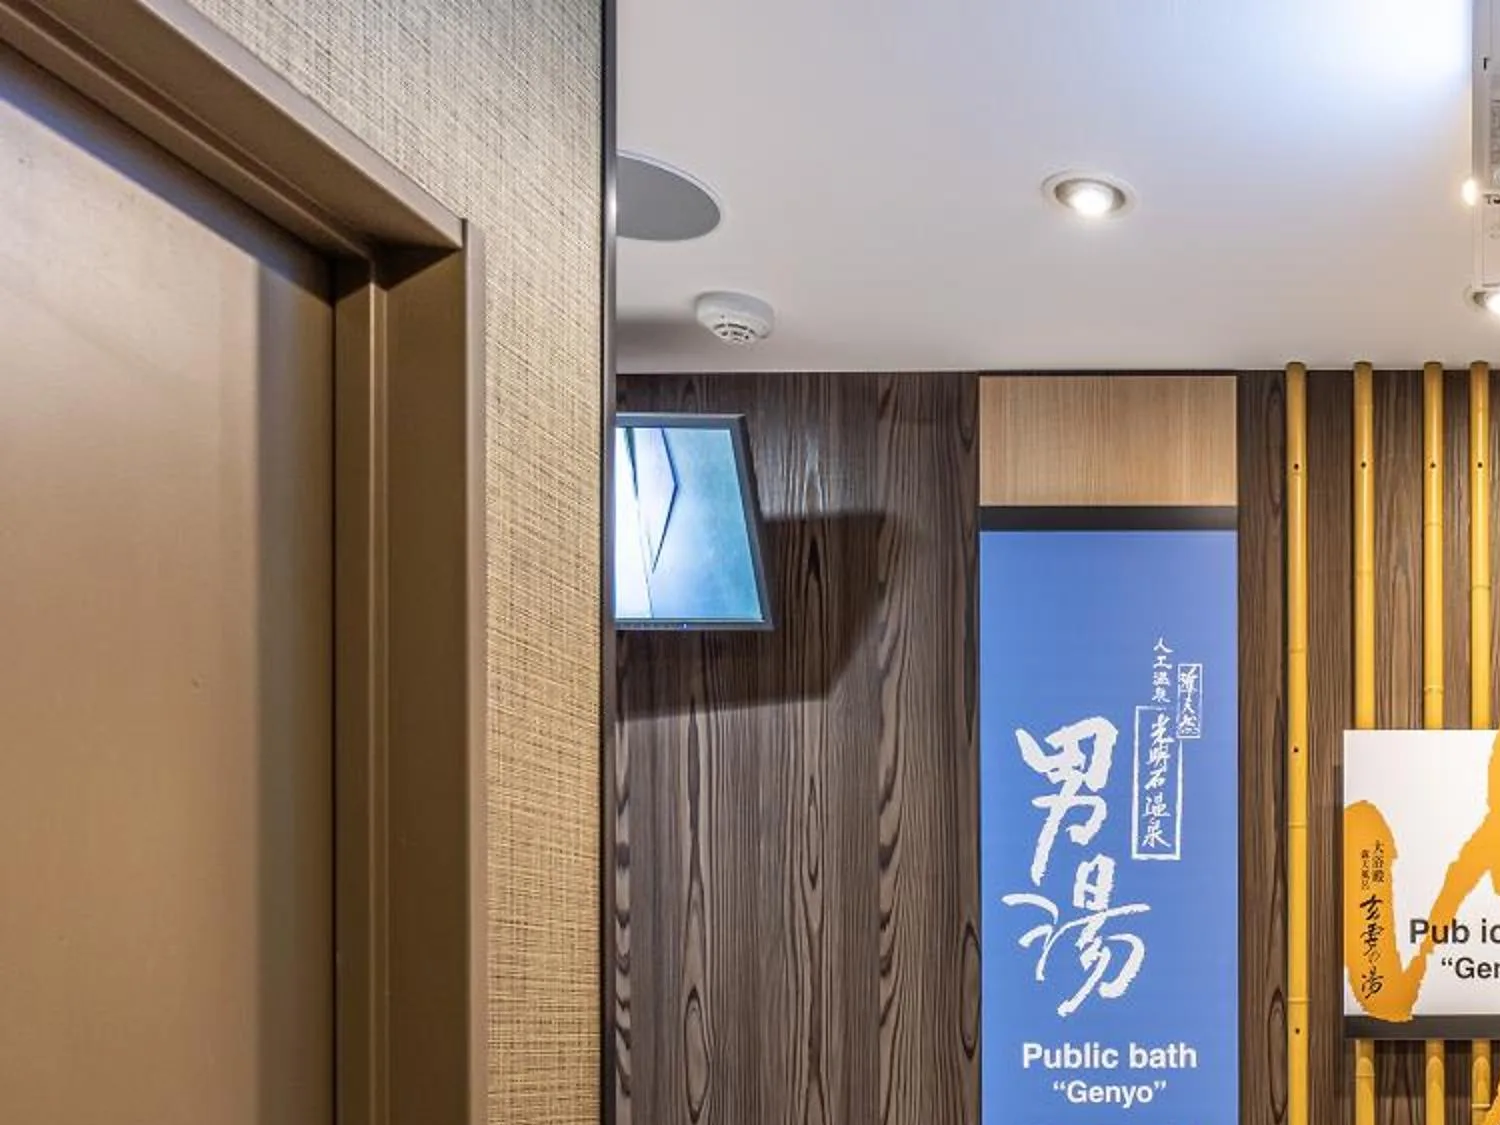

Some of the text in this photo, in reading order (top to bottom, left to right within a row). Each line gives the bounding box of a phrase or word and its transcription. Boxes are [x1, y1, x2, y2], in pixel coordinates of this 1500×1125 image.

[1153, 637, 1173, 703] 人工温泉
[1001, 716, 1150, 1018] 男湯
[1023, 1043, 1197, 1069] Public bath
[1053, 1081, 1167, 1108] “Genyo”
